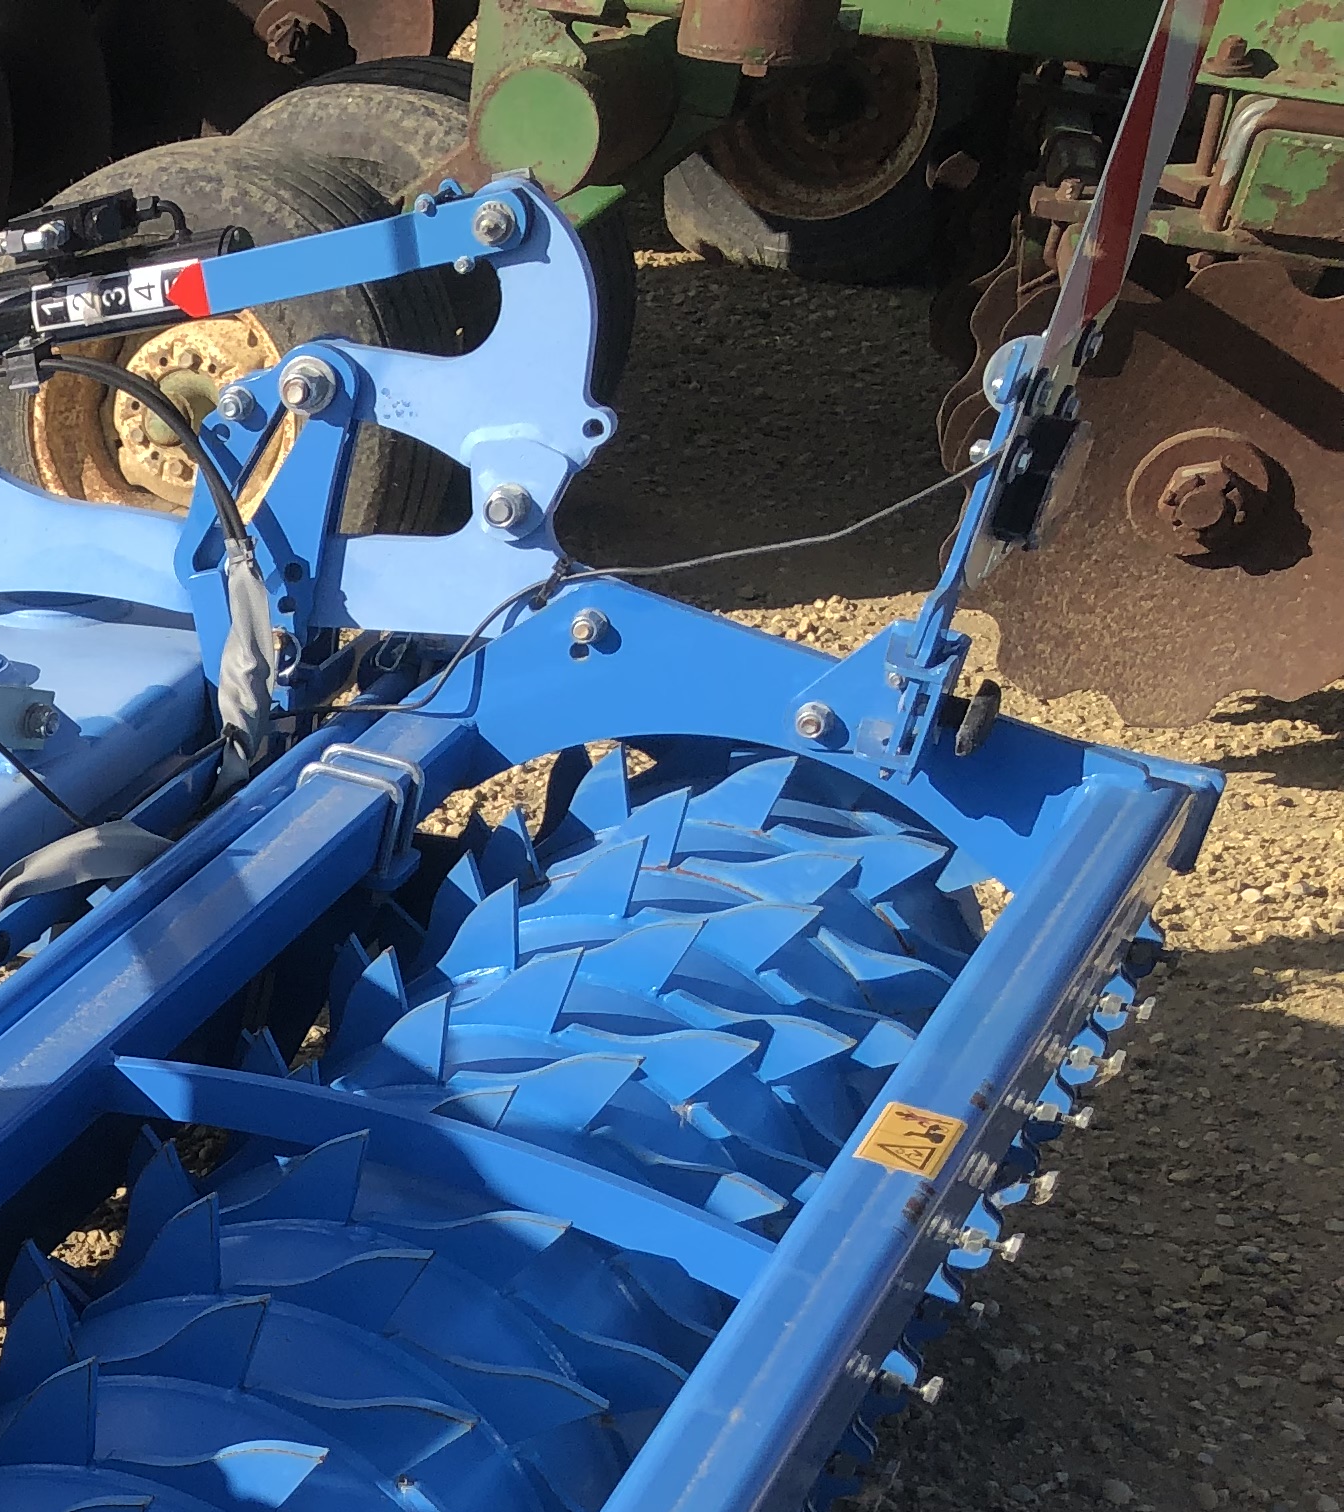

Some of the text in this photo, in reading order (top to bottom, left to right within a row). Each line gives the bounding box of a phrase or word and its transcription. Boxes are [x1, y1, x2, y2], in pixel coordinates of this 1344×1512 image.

[41, 301, 64, 316] 1
[102, 286, 126, 308] 3
[134, 282, 156, 301] 4
